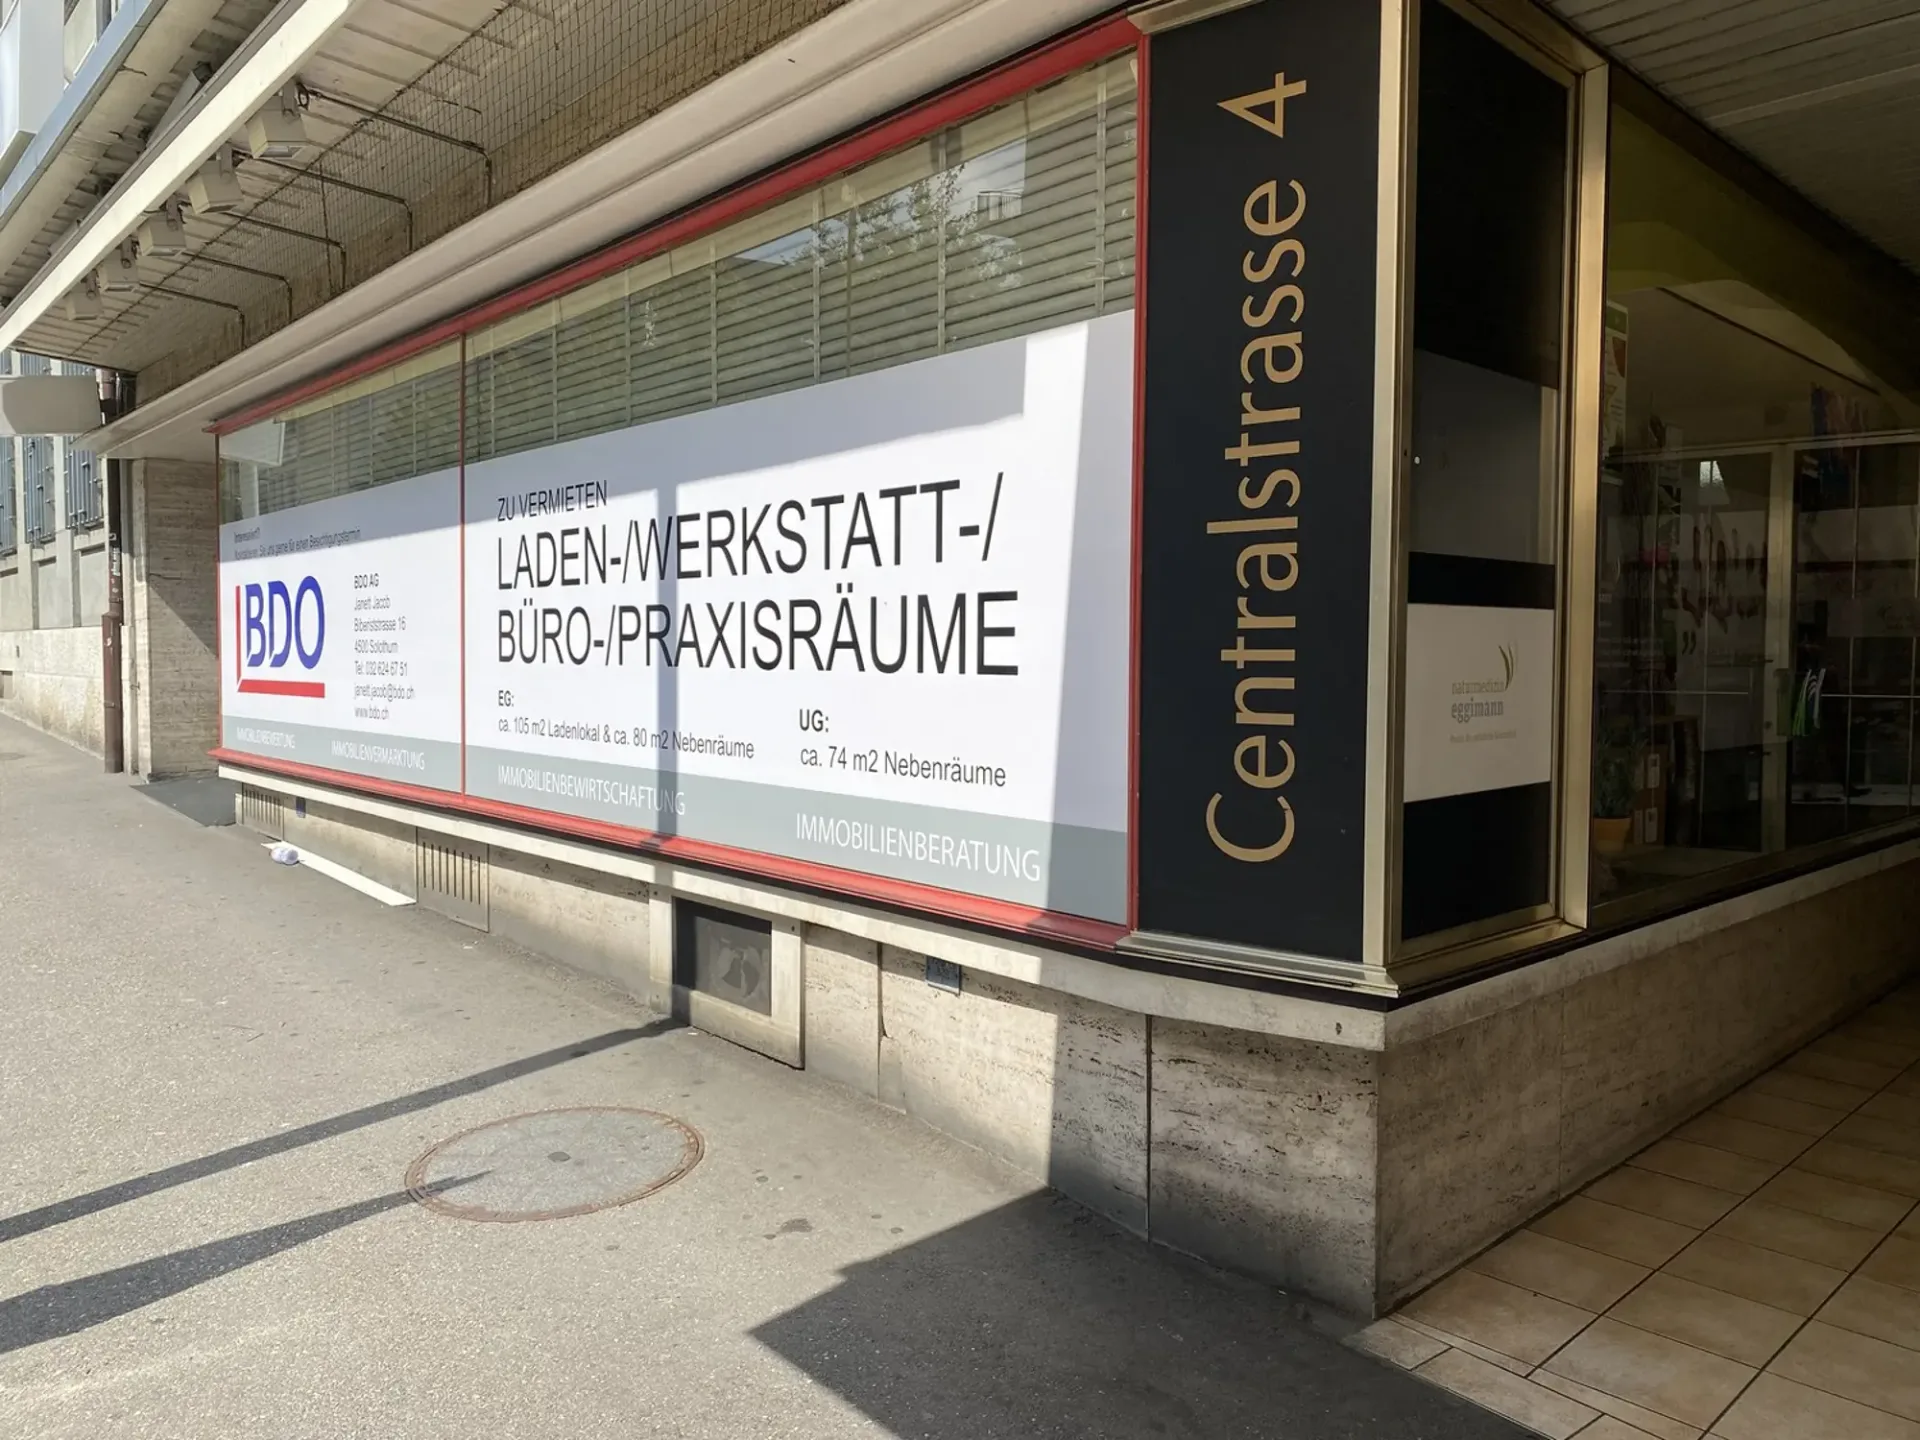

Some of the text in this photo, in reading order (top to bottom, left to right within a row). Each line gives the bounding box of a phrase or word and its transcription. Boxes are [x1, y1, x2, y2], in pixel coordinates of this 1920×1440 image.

[1206, 71, 1308, 863] Centralstrasse 4
[497, 480, 608, 522] ZU VERMIETEN
[498, 471, 1005, 590] LADEN-/WERKSTATT-/
[354, 573, 379, 589] BDO AG
[245, 575, 325, 669] BDO
[498, 583, 1019, 676] BÜRO-/PRAXISRÄUME
[498, 690, 514, 707] EG:
[1451, 697, 1504, 724] eggimann
[498, 716, 755, 759] ca. 105 m2 Ladenlokal & ca. 80 m2 Nebenräume
[799, 709, 830, 734] UG:
[800, 746, 1006, 788] ca. 74 m2 Nebenräume
[498, 765, 686, 817] IMMOBILIENBEWIRTSCHAFTUNG
[796, 812, 1041, 882] IMMOBILIENBERATUNG
